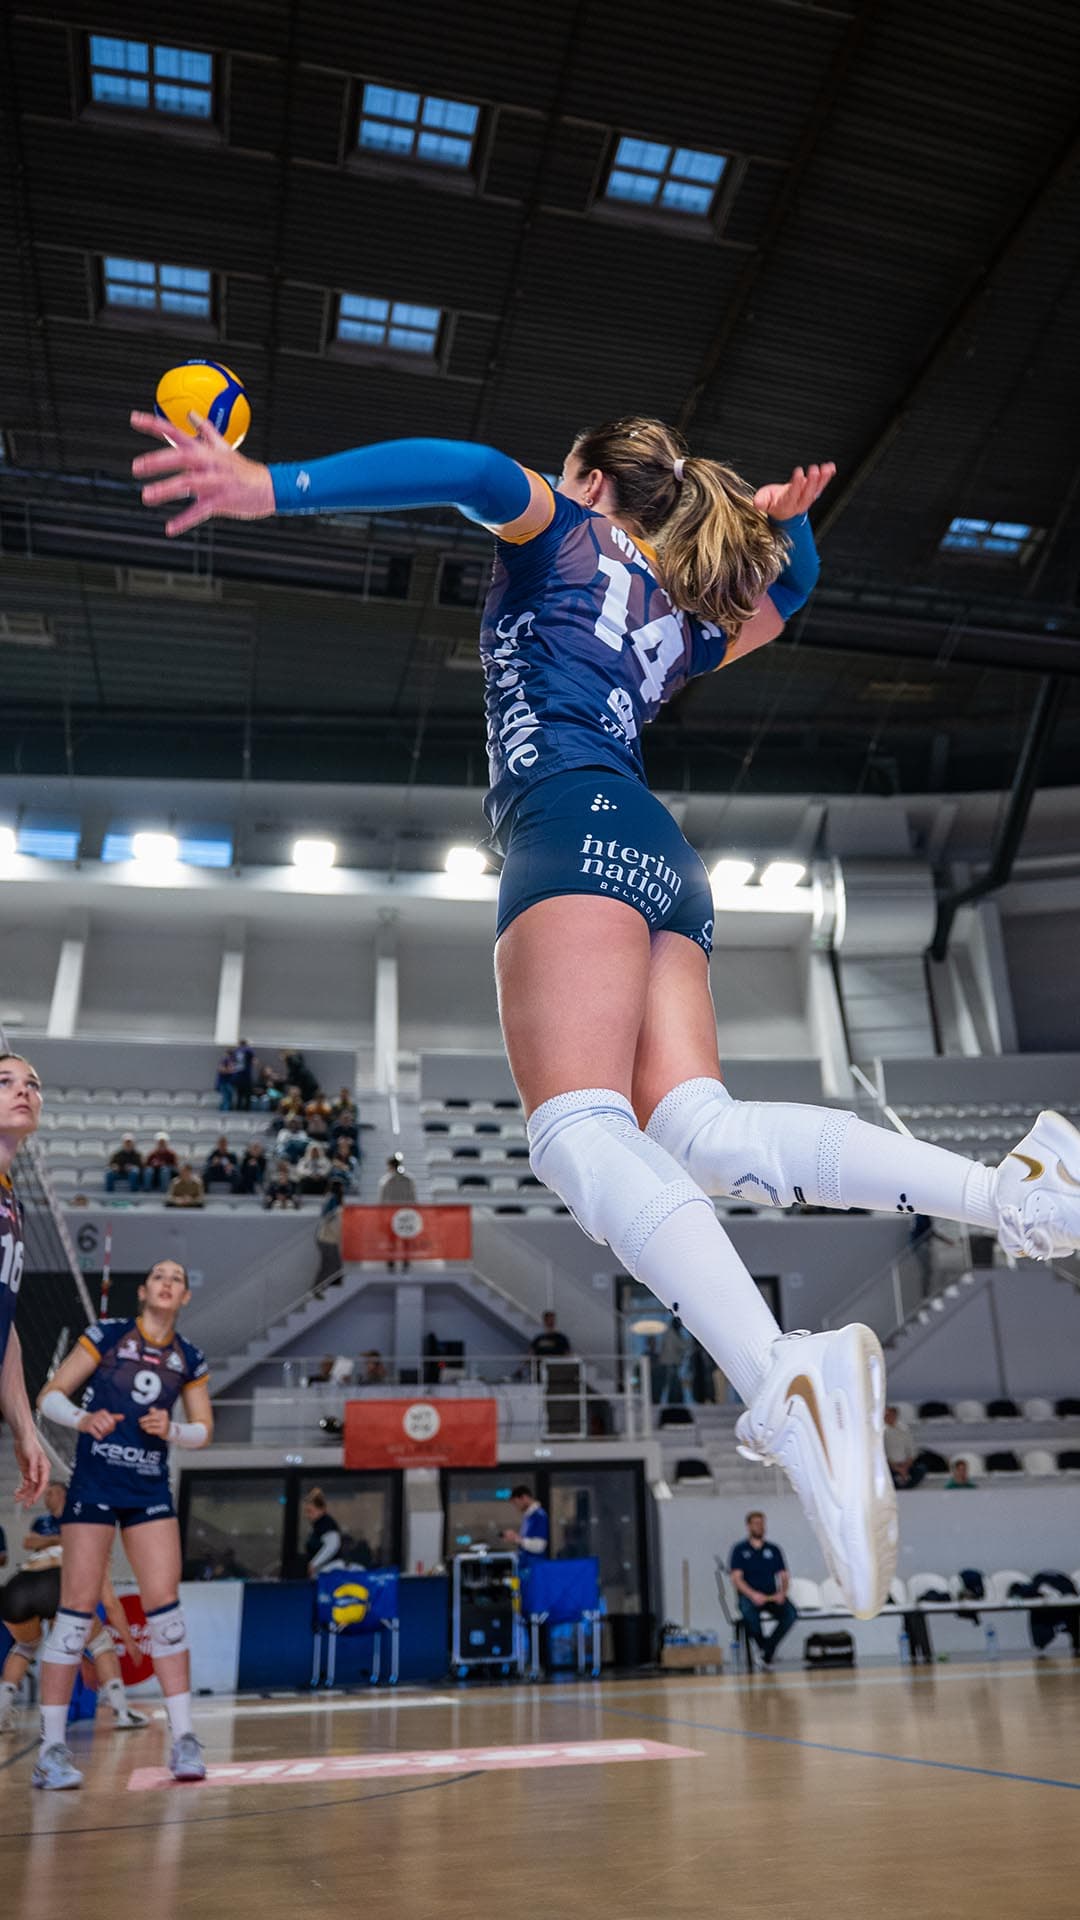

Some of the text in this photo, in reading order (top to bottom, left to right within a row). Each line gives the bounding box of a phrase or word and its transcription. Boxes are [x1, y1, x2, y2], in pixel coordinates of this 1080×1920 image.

[594, 553, 685, 704] 14
[580, 834, 682, 896] interim
[580, 857, 672, 916] nation
[0, 1232, 24, 1293] 16
[77, 1223, 99, 1253] 6
[131, 1370, 162, 1405] 9
